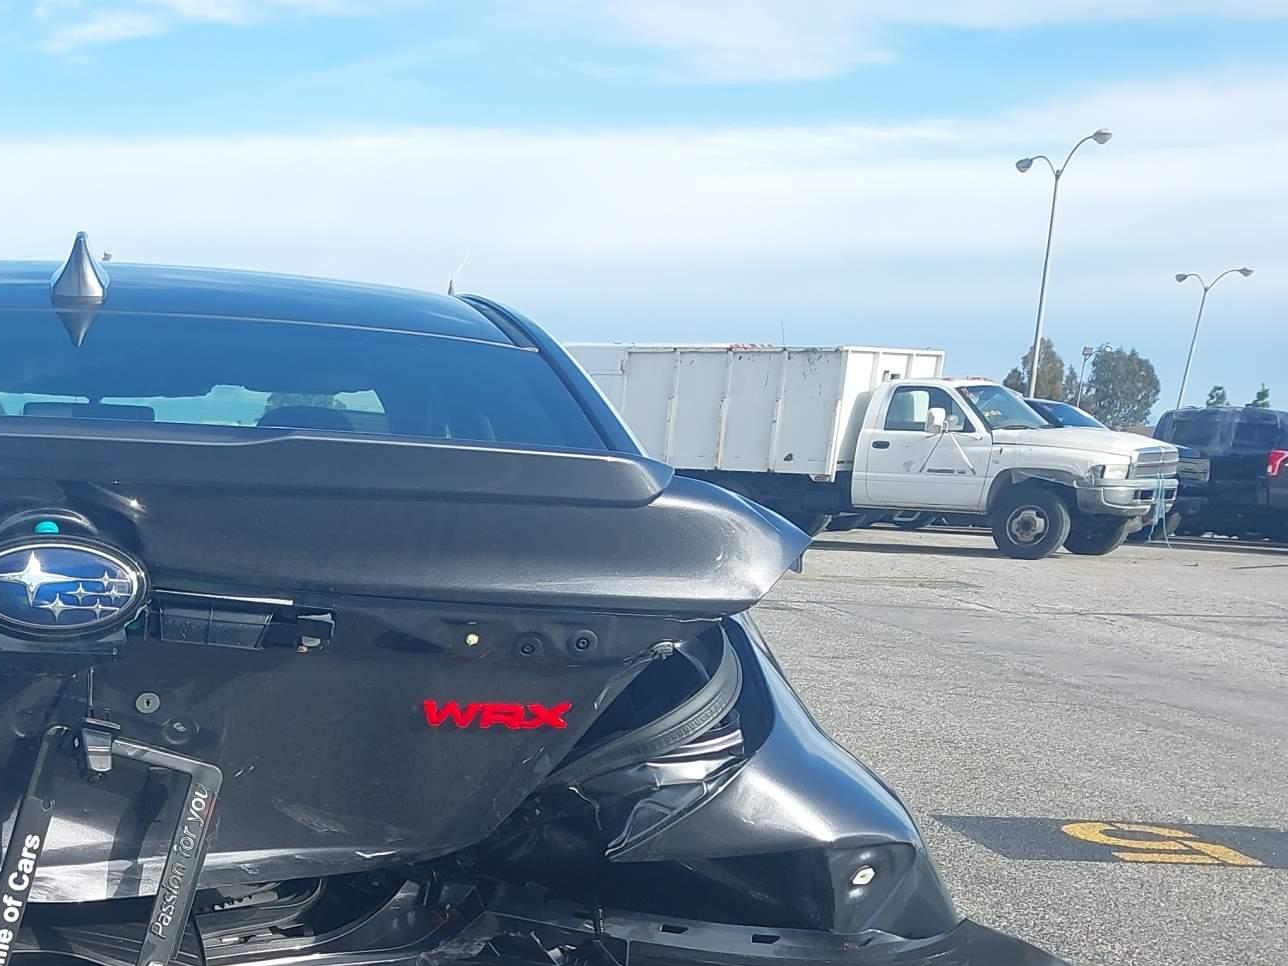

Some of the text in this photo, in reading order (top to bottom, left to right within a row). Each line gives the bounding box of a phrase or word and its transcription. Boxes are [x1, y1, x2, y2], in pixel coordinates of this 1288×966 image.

[424, 698, 573, 729] WRX
[8, 834, 41, 892] Cars
[150, 783, 211, 940] Passion for you
[3, 894, 24, 923] of
